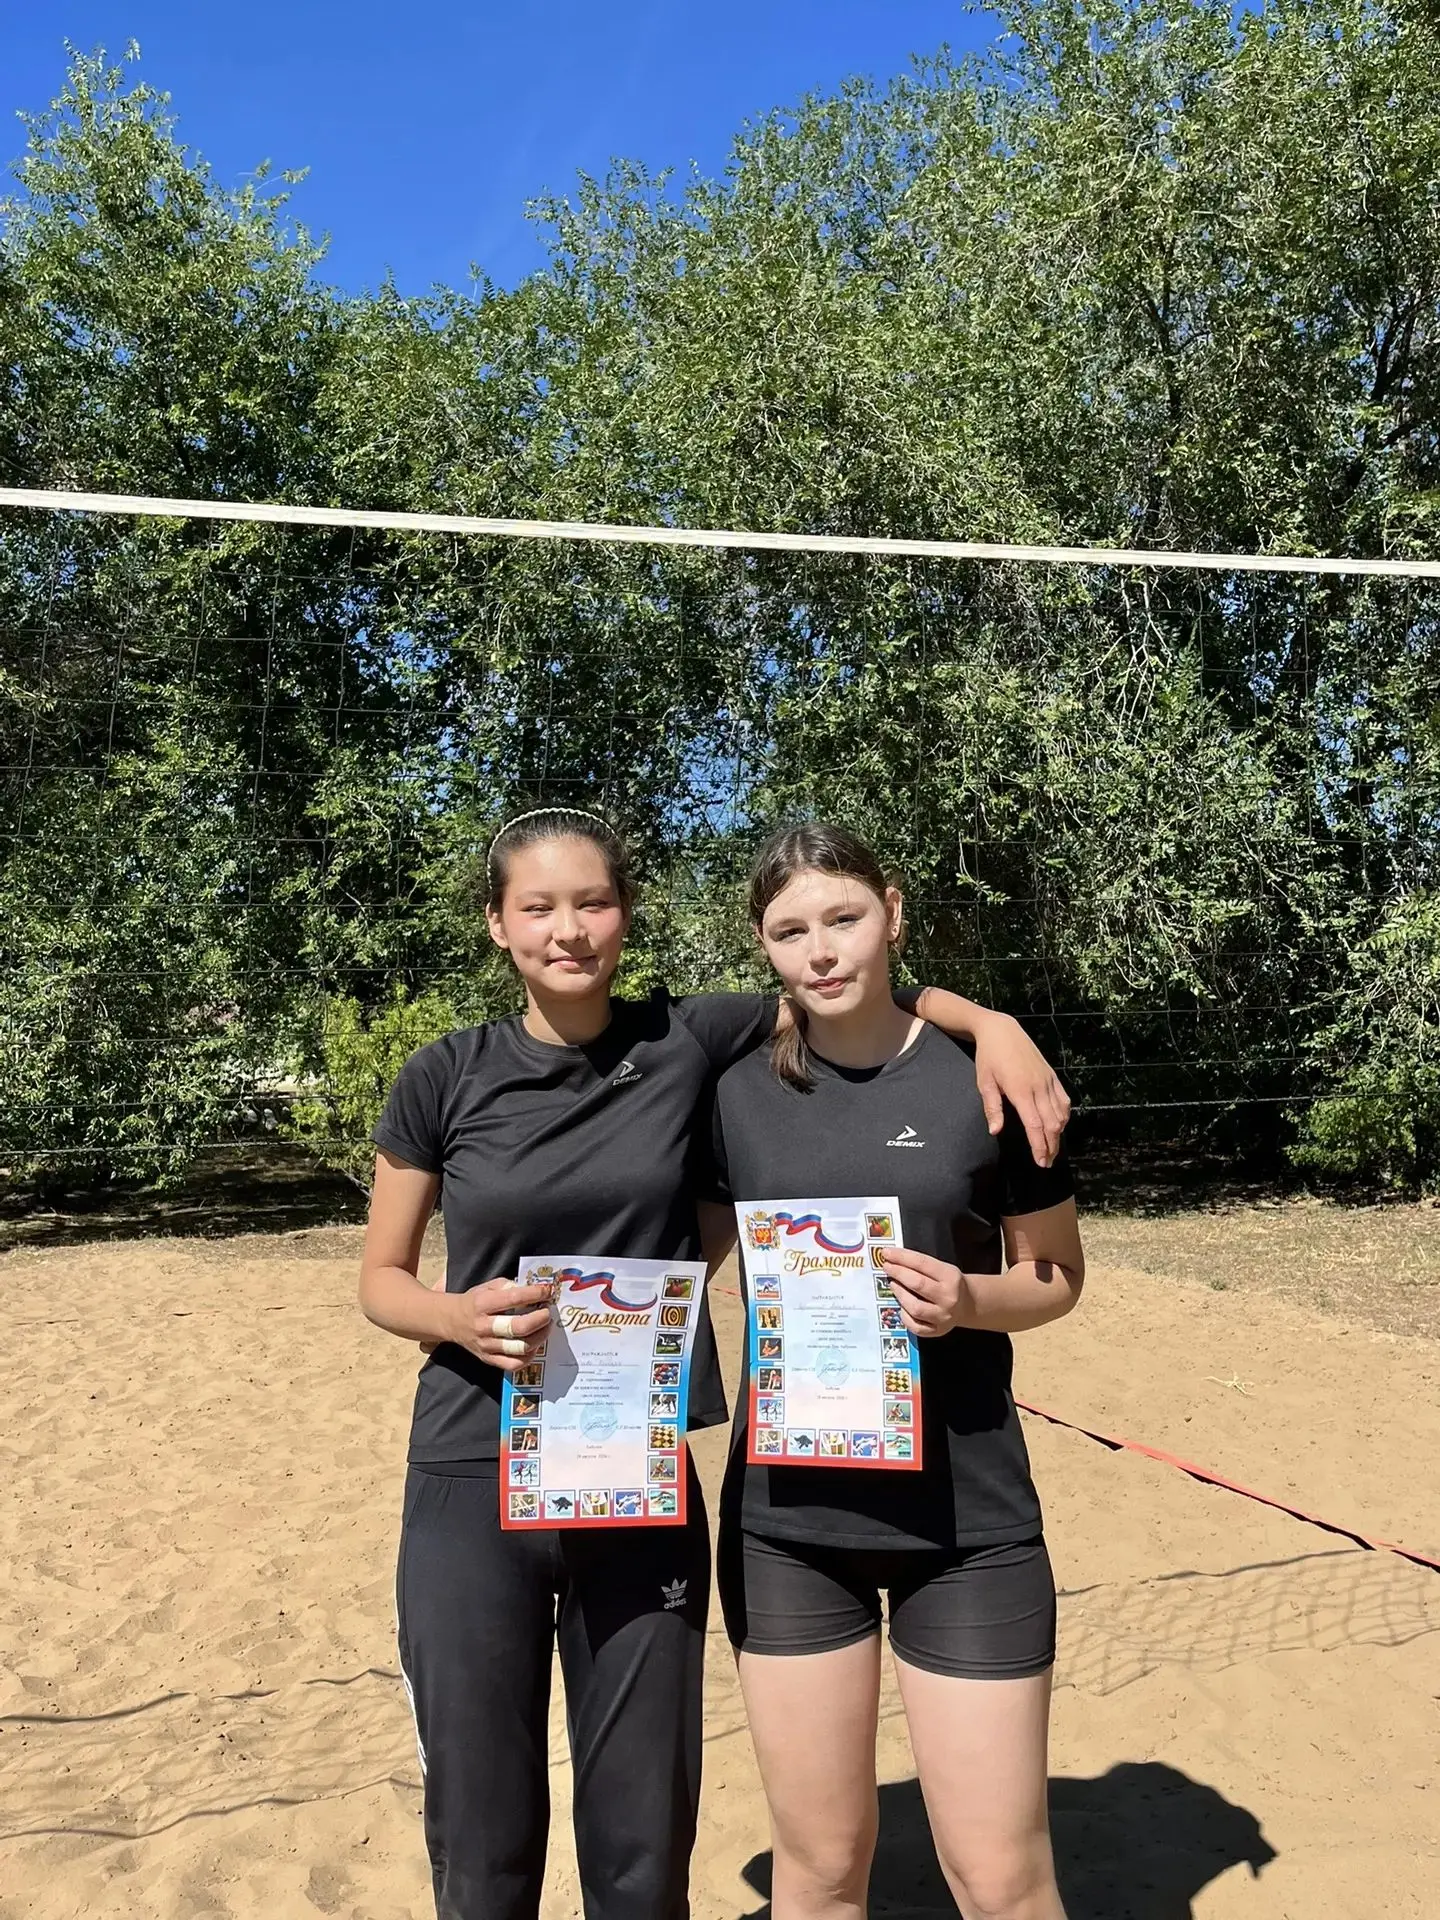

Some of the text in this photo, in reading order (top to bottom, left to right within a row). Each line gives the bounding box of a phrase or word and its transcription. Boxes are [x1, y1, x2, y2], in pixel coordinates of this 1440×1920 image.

[612, 1072, 643, 1087] DEMIX
[886, 1140, 926, 1148] DEMIX
[784, 1249, 865, 1276] Грамота
[558, 1305, 652, 1334] Грамота
[663, 1597, 687, 1610] adidas
